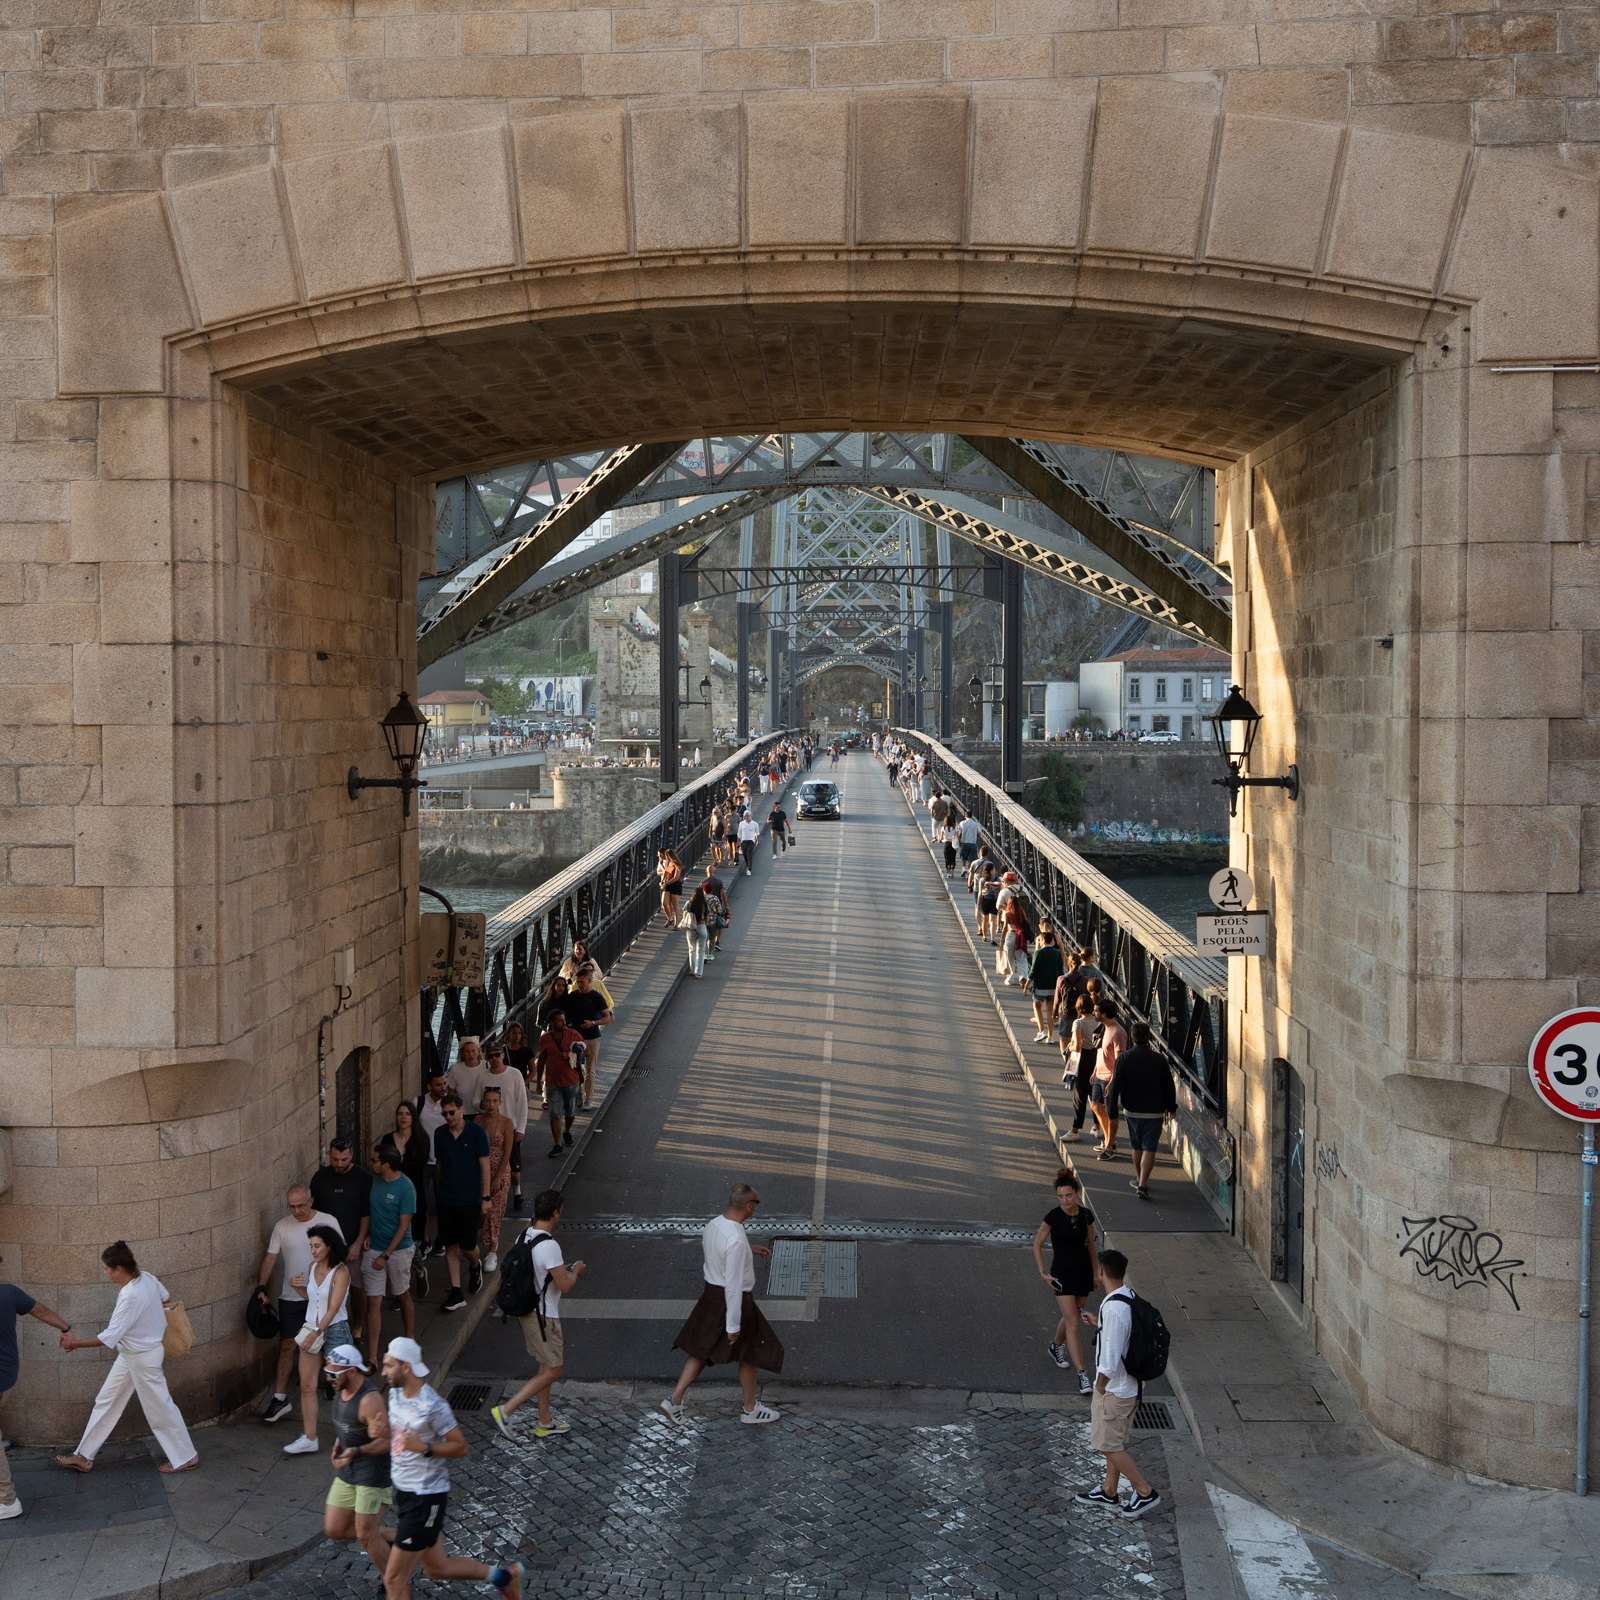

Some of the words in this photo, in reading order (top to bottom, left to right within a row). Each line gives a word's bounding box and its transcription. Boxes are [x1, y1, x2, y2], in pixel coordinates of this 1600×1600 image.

[1214, 917, 1249, 926] PEÕES
[1217, 927, 1245, 935] PELA
[1203, 936, 1260, 946] ESQUERDA
[1553, 1044, 1600, 1085] 3
